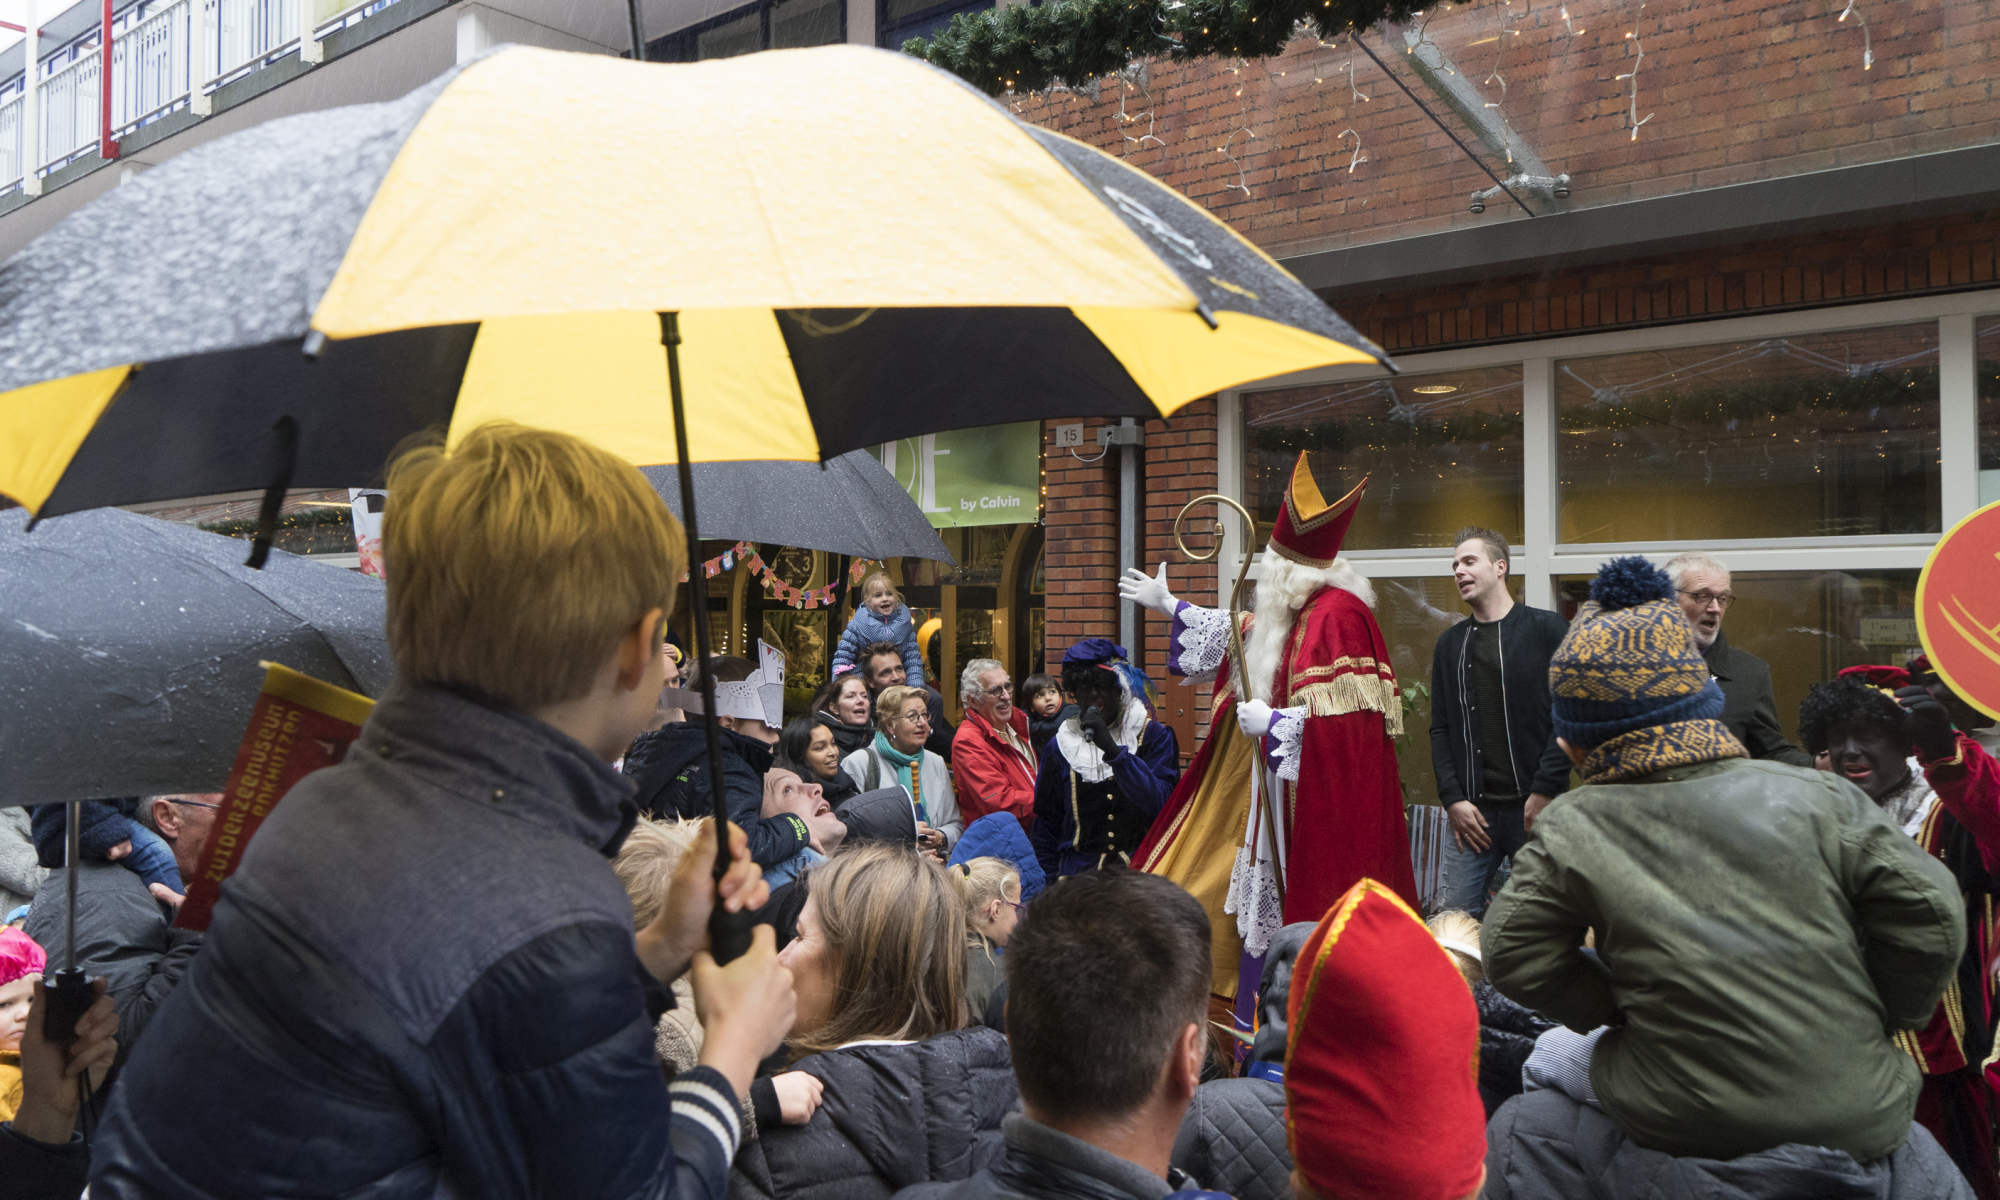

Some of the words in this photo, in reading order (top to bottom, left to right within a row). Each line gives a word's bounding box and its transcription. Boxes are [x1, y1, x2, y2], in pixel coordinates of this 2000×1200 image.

[1063, 429, 1077, 442] 15
[960, 498, 977, 512] by
[979, 495, 1020, 509] Calvin
